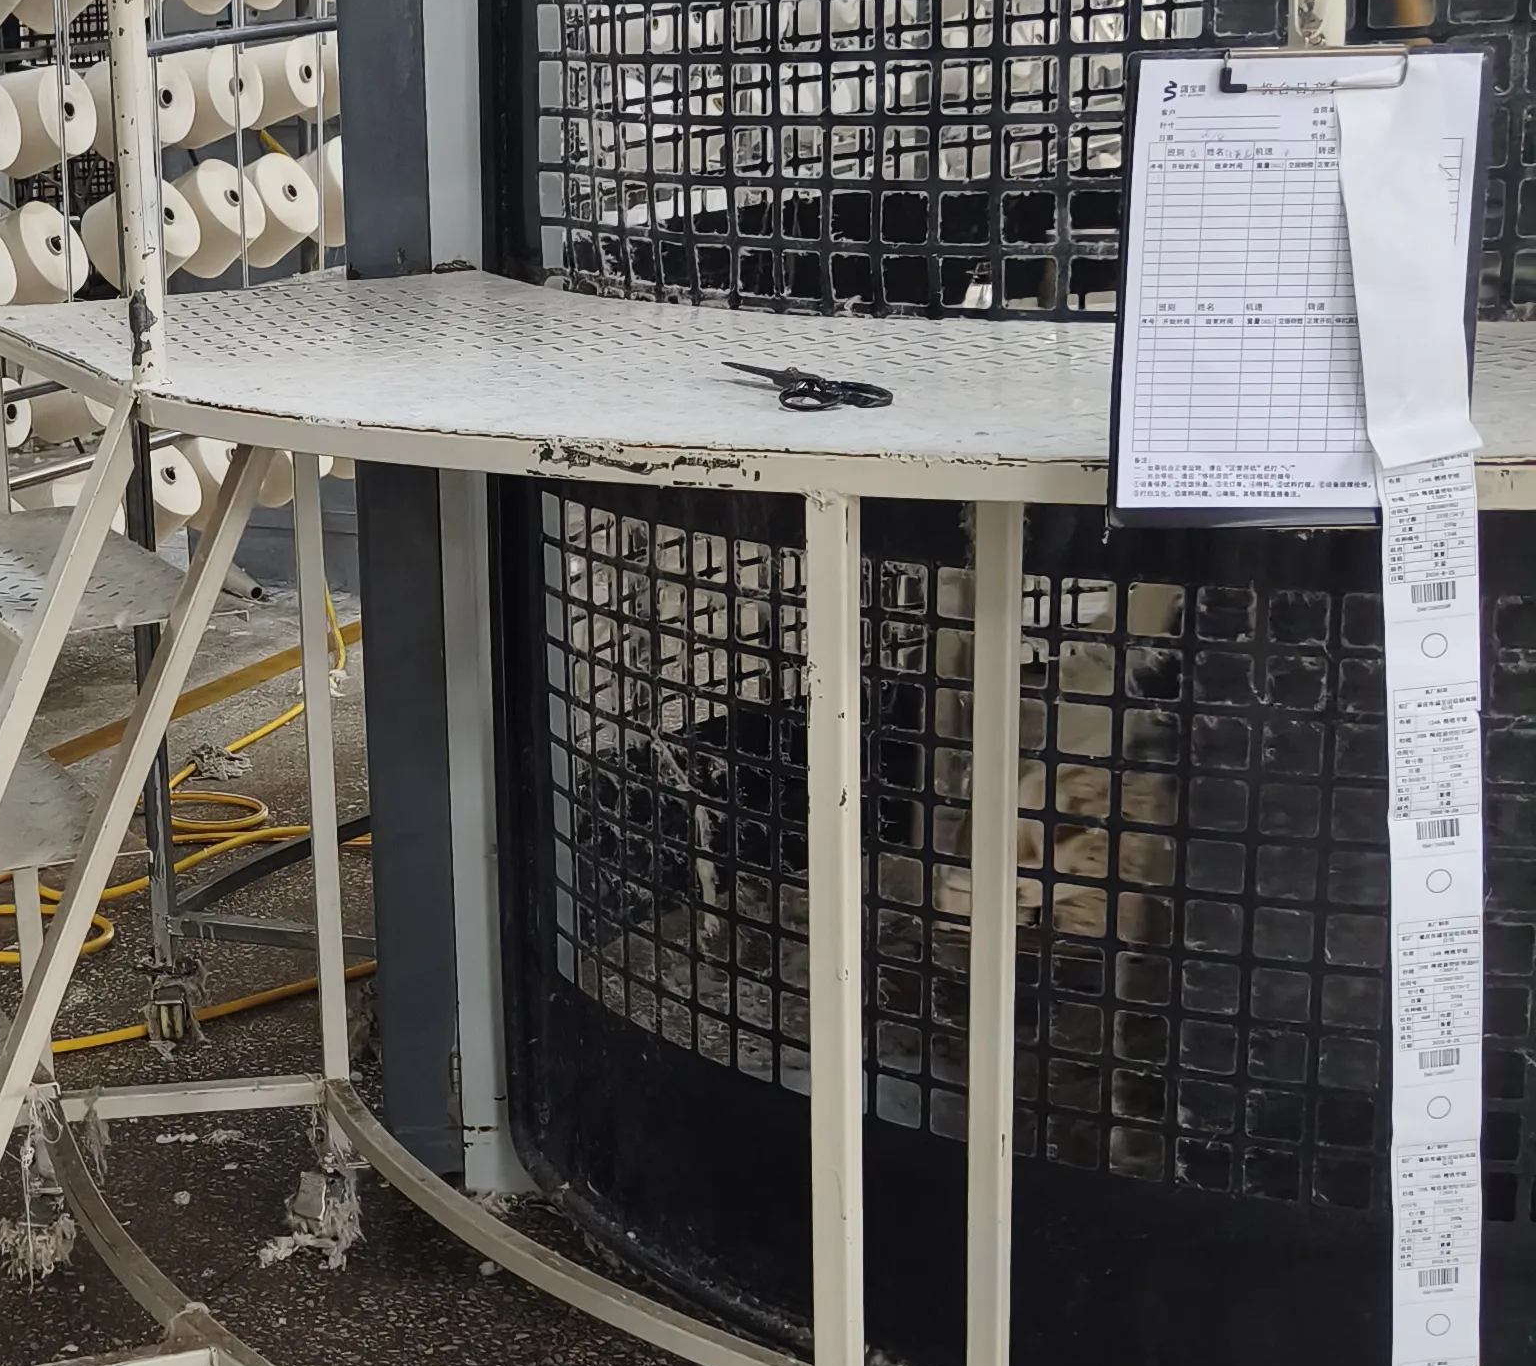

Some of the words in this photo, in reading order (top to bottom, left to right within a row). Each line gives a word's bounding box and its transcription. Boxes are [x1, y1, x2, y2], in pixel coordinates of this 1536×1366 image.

[1206, 148, 1224, 156] 姓名
[1197, 303, 1215, 312] 姓名
[1246, 303, 1263, 312] 机速
